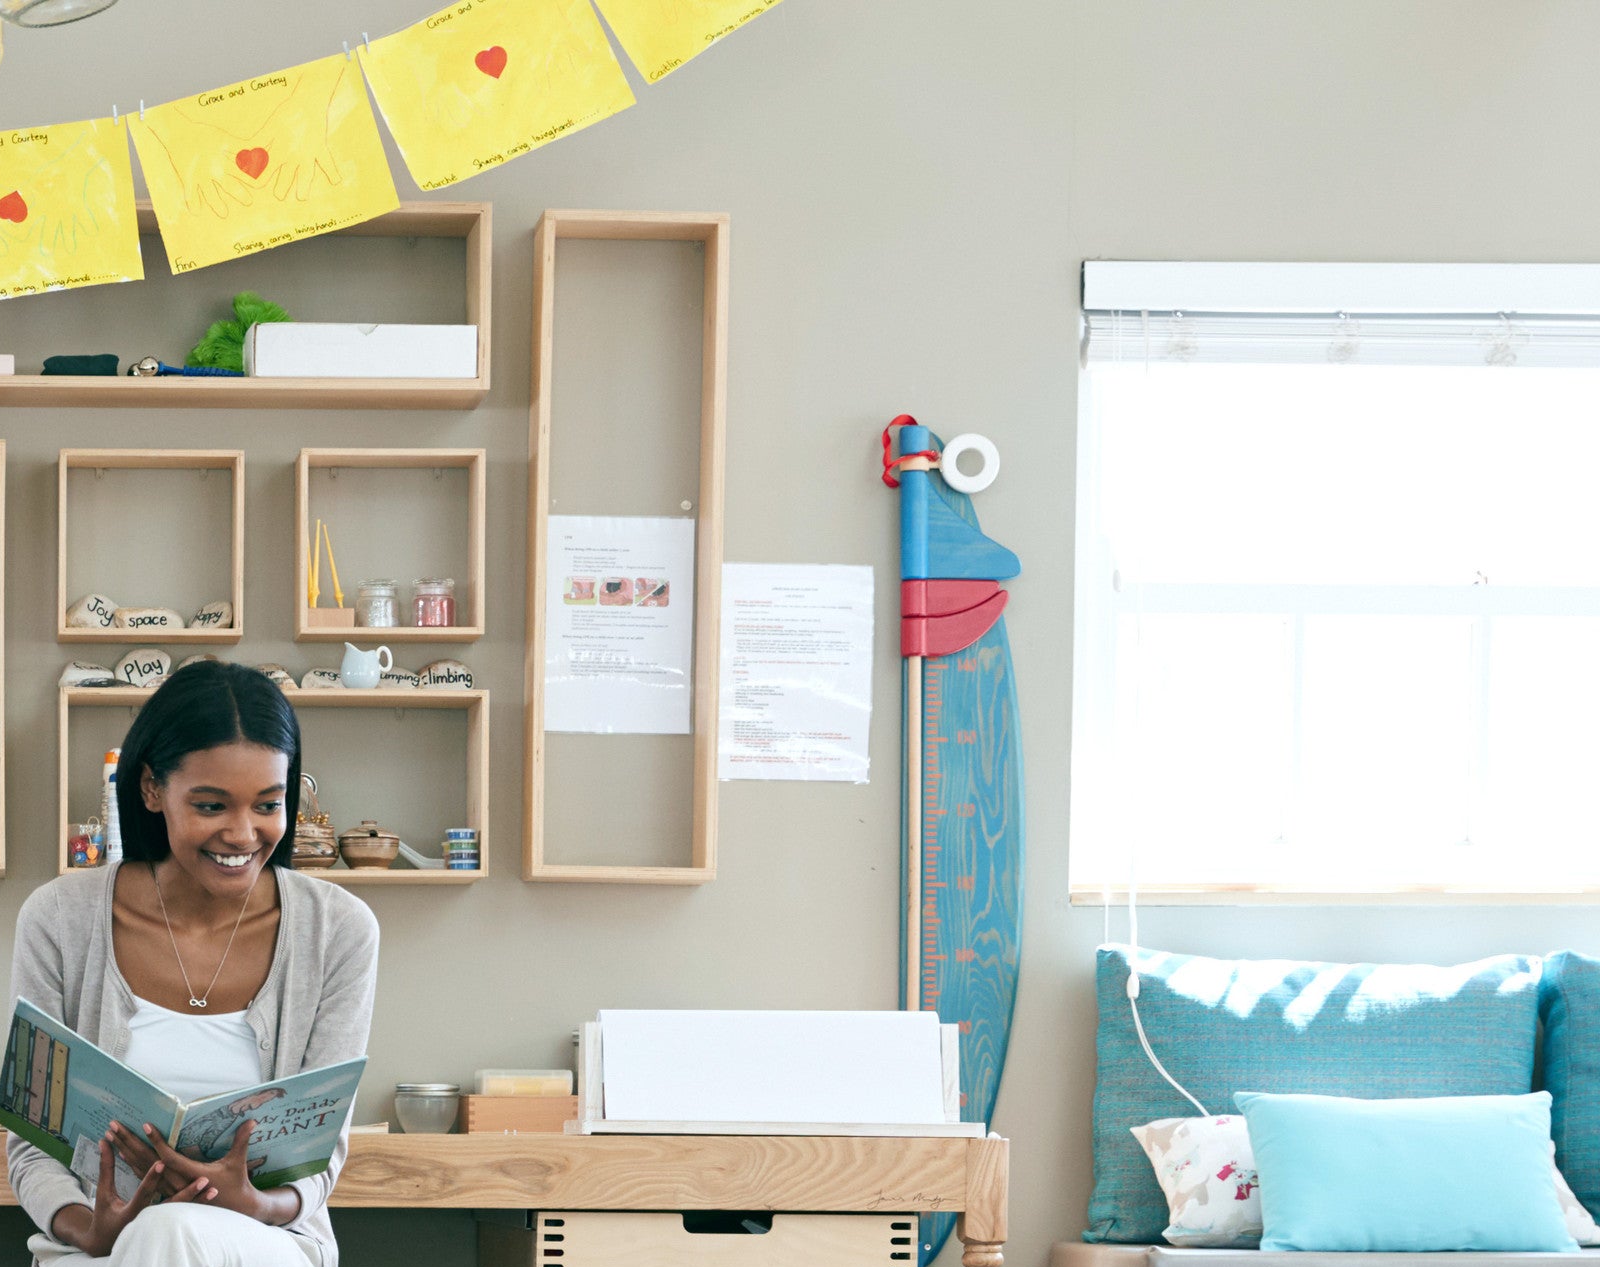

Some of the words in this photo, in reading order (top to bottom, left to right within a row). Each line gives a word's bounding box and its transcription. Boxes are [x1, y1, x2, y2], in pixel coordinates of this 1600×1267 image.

[426, 13, 453, 30] Grace
[457, 3, 473, 16] and
[649, 58, 683, 81] Caitlin
[198, 93, 225, 107] Grace
[228, 87, 245, 98] and
[250, 75, 288, 91] Courtesy
[11, 133, 49, 145] Courtesy
[174, 255, 197, 273] Finn
[86, 596, 115, 628] Joy
[128, 613, 168, 629] space
[380, 672, 420, 688] umping
[956, 802, 976, 818] 120
[254, 1114, 279, 1126] My
[285, 1096, 341, 1118] Daddy
[248, 1109, 336, 1147] GIANT
